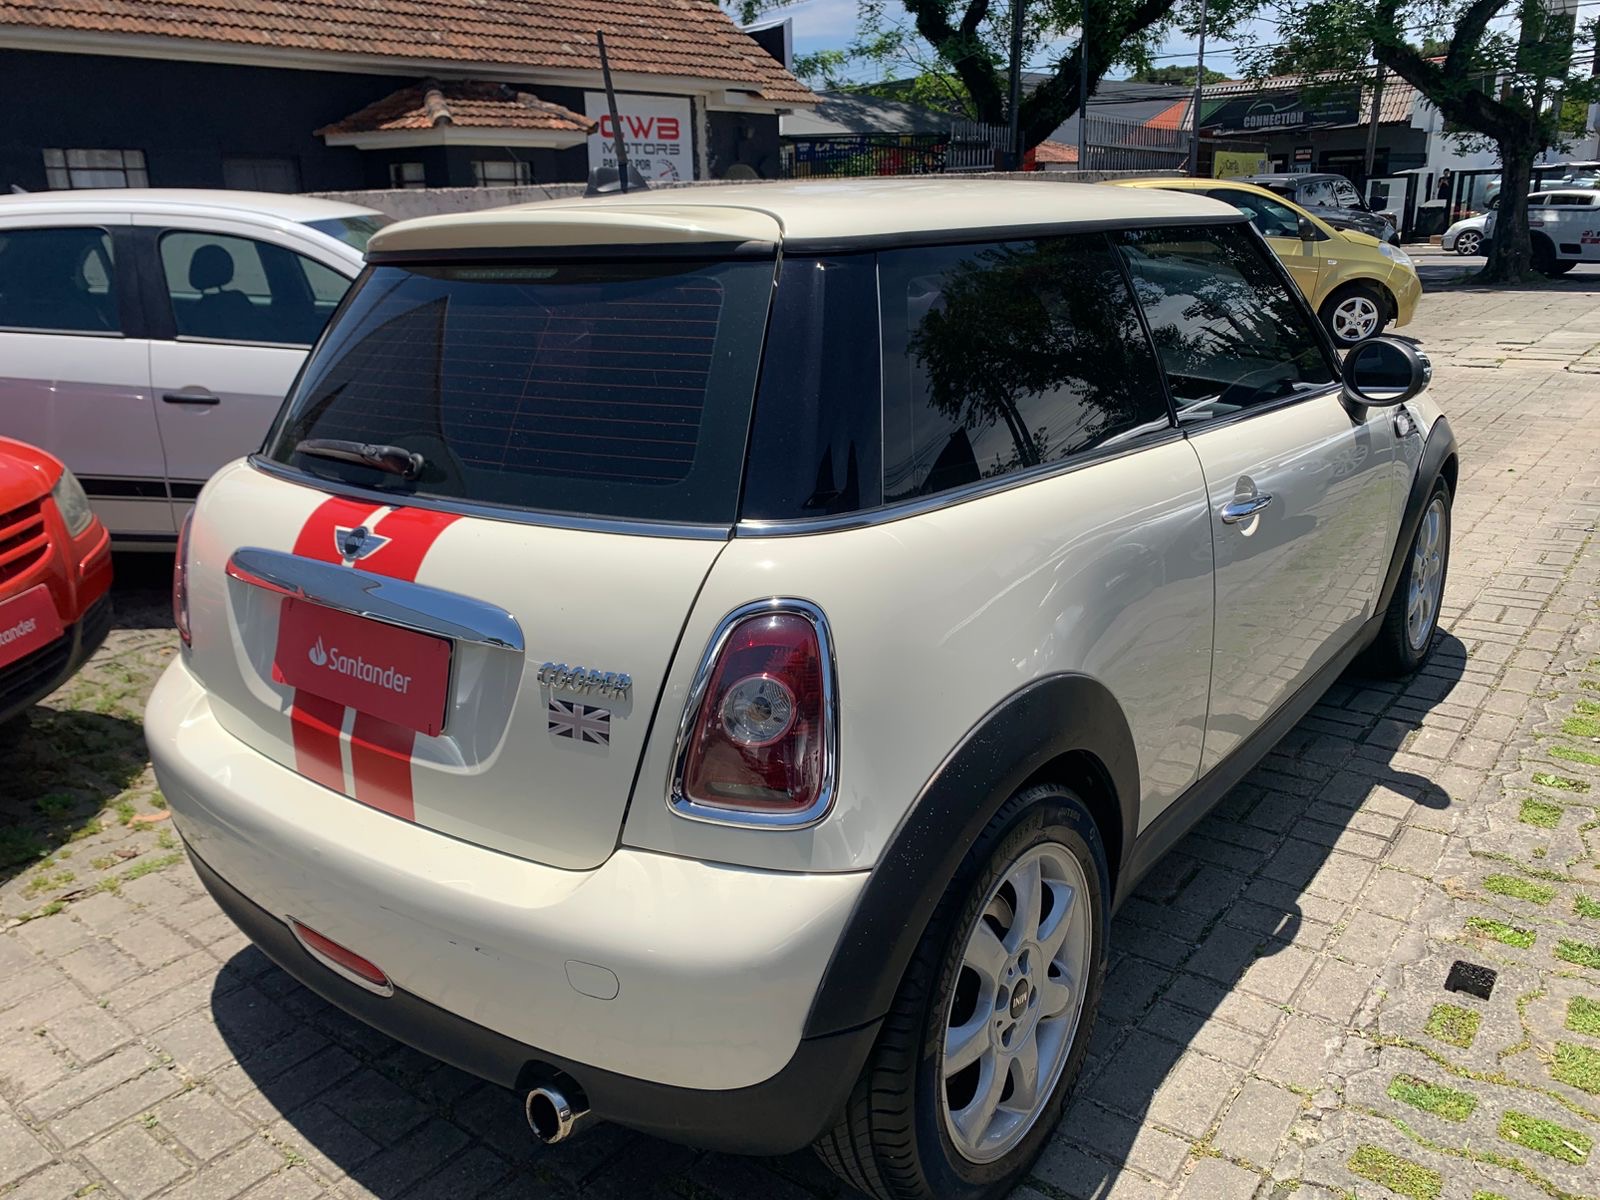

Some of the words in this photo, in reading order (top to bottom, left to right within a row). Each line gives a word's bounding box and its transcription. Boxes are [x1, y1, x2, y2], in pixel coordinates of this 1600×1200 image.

[600, 115, 679, 140] CWB
[1243, 112, 1303, 127] CONNECTION
[328, 647, 412, 694] Santander
[537, 662, 632, 700] COOPER
